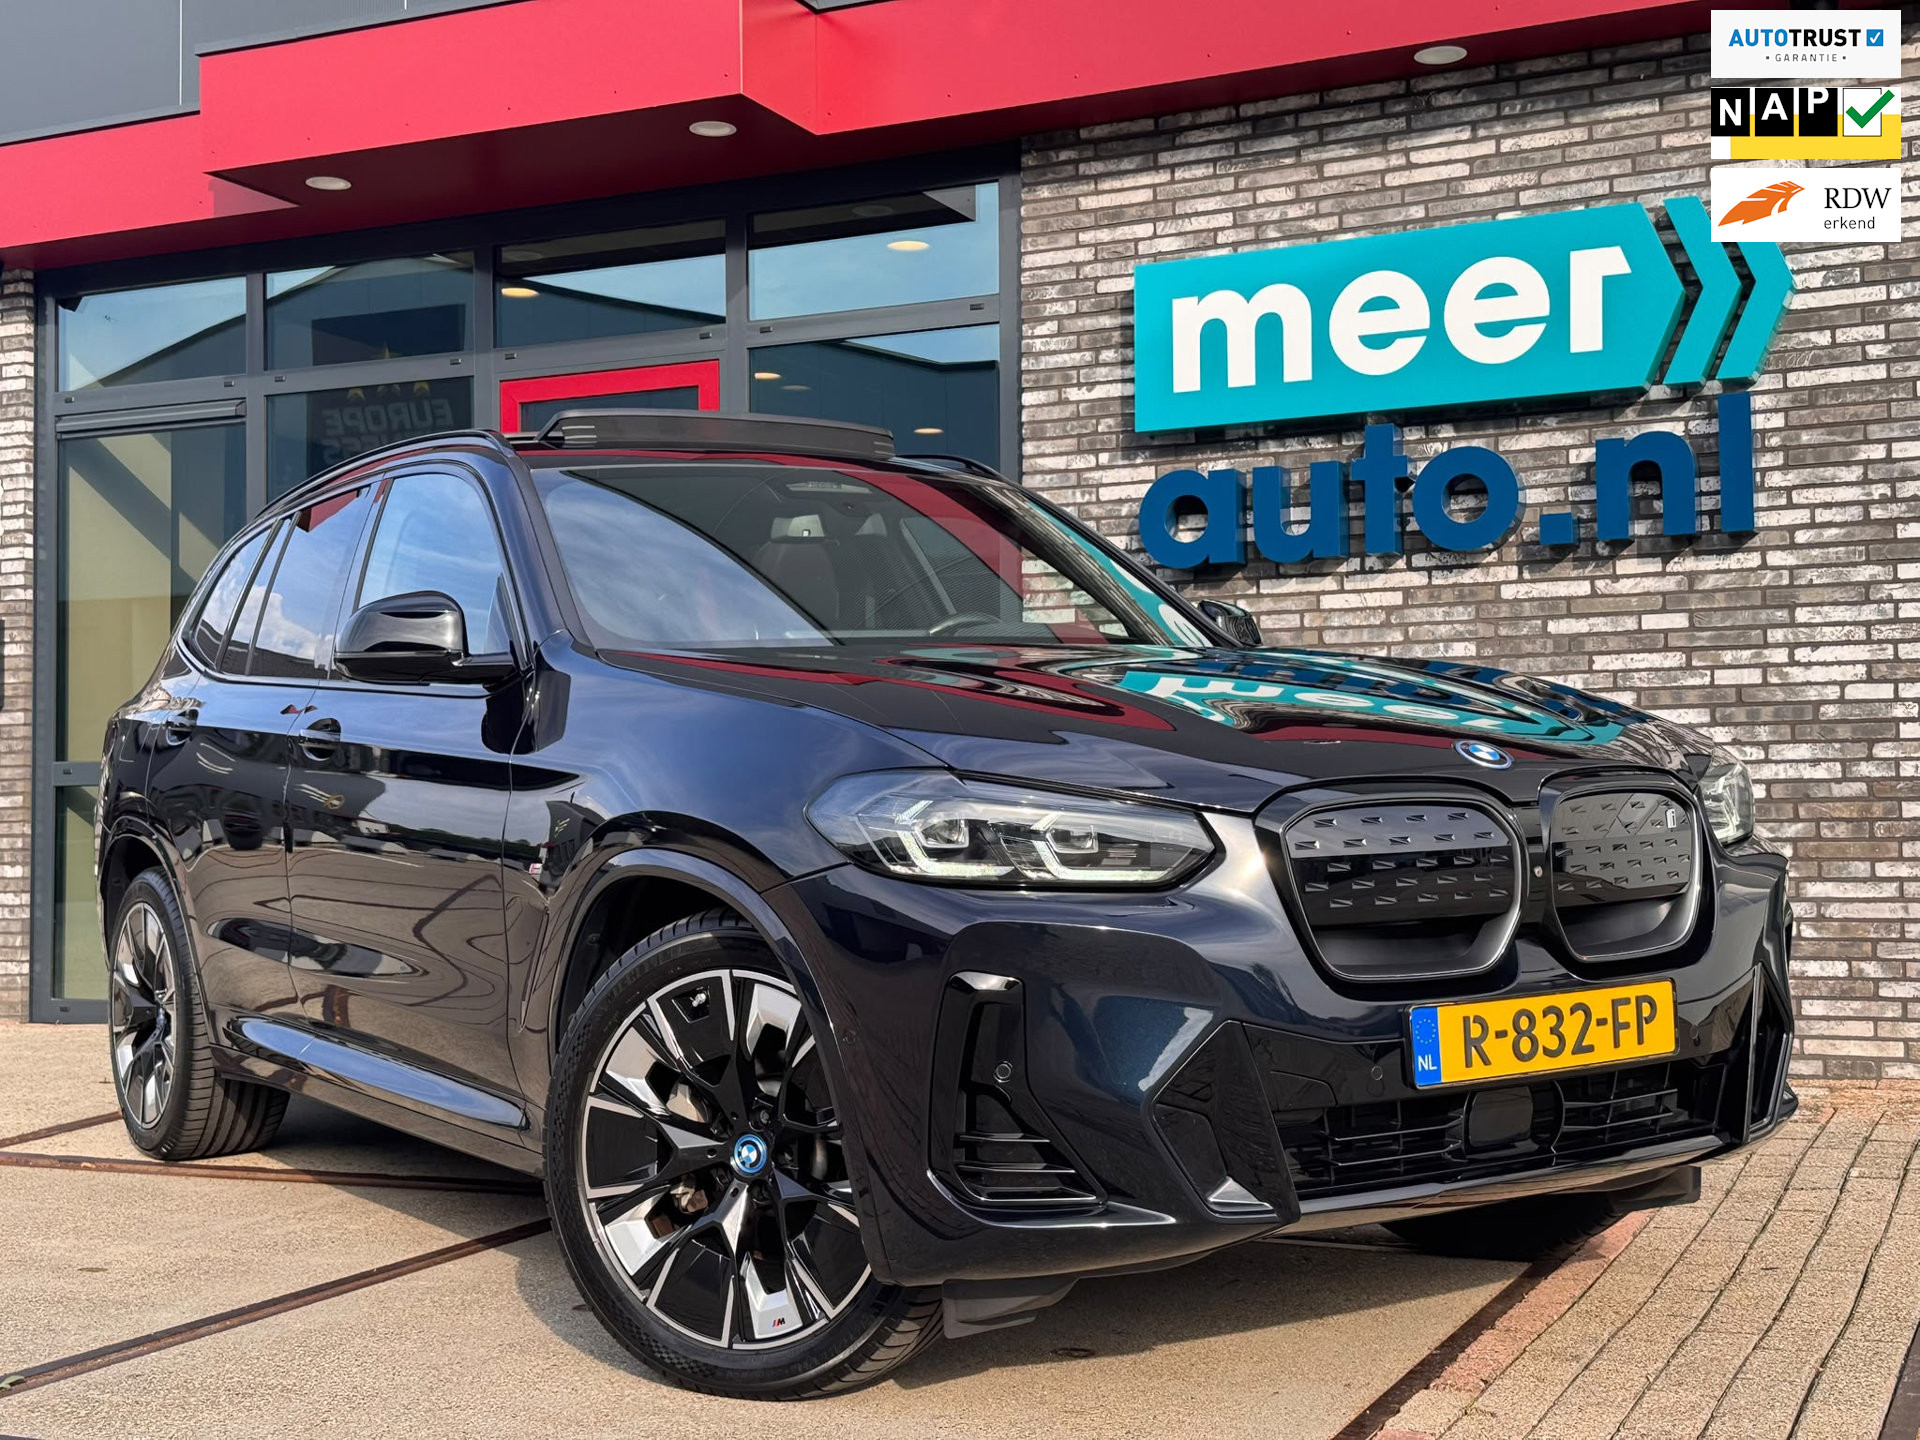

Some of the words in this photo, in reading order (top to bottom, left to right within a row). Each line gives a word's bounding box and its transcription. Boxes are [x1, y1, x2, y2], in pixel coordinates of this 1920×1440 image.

[1172, 246, 1632, 393] meer
[1138, 391, 1756, 570] auto.nl
[1417, 1054, 1438, 1072] NL
[1462, 994, 1658, 1069] R-832-FP
